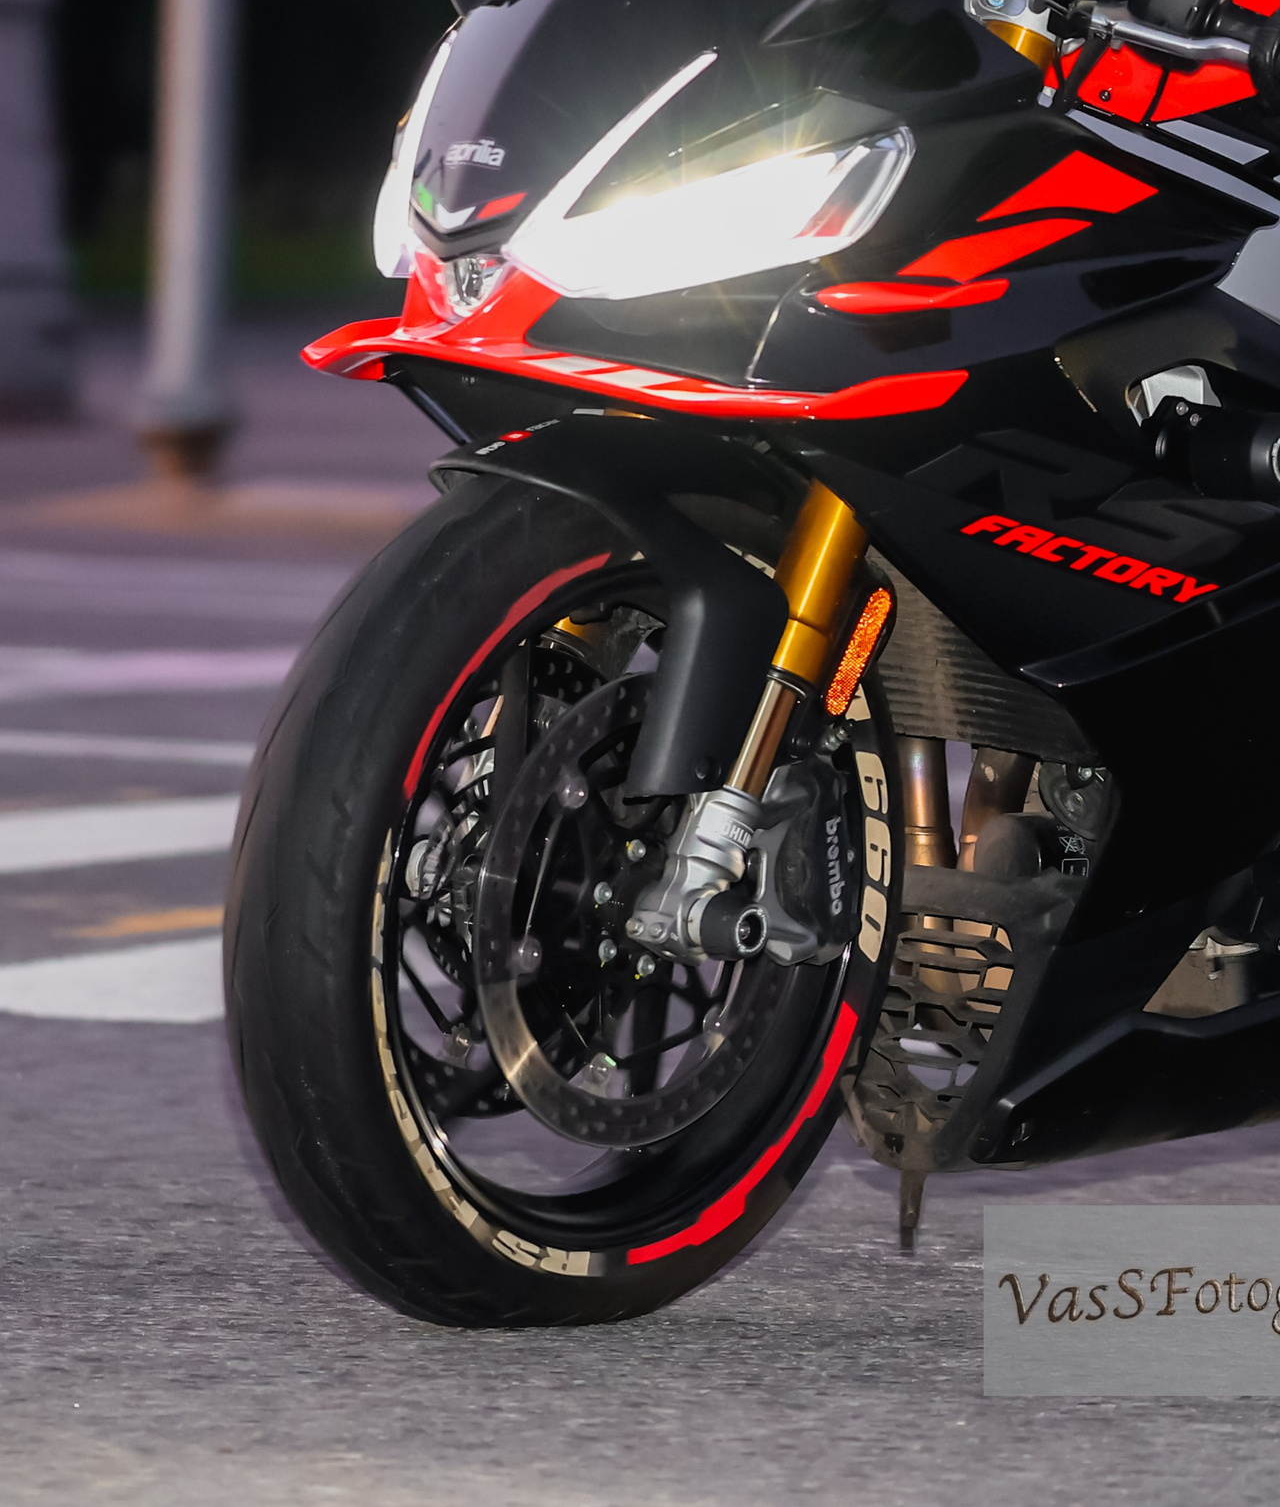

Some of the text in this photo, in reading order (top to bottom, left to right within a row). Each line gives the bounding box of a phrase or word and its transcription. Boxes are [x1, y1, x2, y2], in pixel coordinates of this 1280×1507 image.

[960, 515, 1219, 603] FACTORY
[825, 815, 846, 916] brembo
[855, 751, 891, 963] 660
